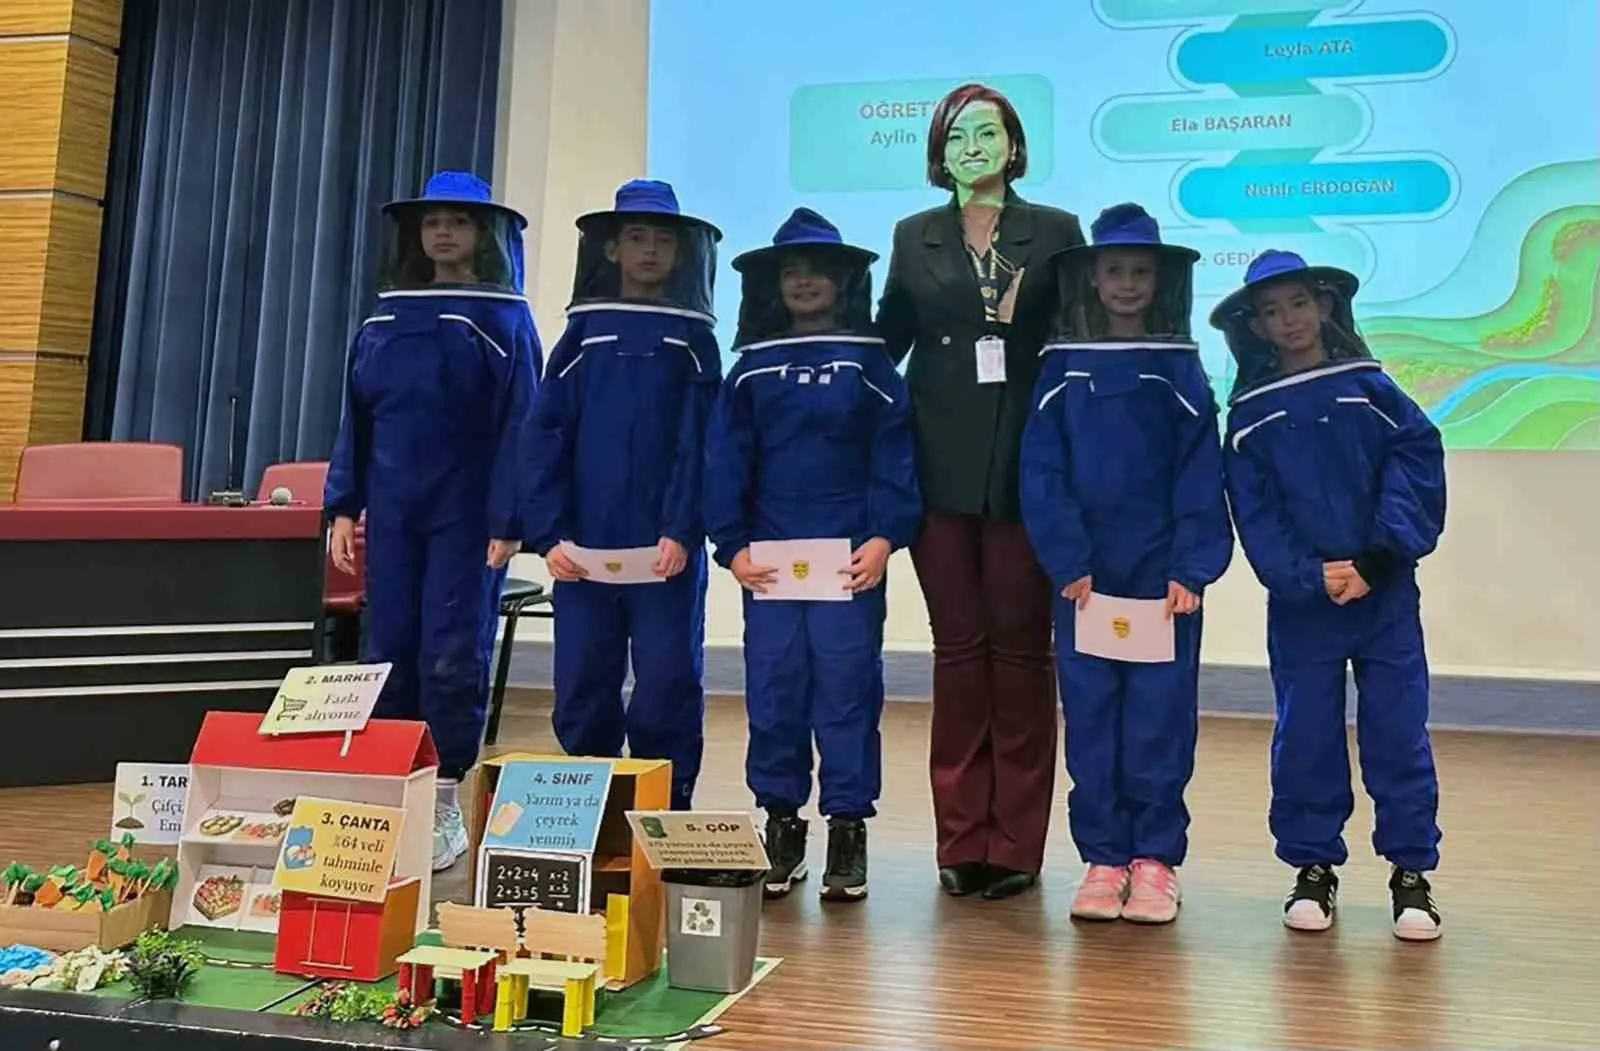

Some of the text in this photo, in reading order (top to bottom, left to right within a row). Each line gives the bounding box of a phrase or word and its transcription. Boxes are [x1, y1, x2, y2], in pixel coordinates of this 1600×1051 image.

[1264, 40, 1353, 58] Leyla ATA
[860, 100, 935, 119] ÖĞRET
[1171, 114, 1292, 132] Ela BAŞARAN
[871, 129, 917, 148] Aylin
[1301, 176, 1395, 195] ERDOĞAN
[1214, 248, 1256, 266] GEDİ
[321, 672, 383, 683] MARKET
[324, 692, 360, 705] Fazla
[142, 775, 188, 788] 1. TAR
[534, 772, 594, 785] 4. SINIF
[525, 793, 600, 808] Yarım ya da
[160, 818, 182, 832] Em
[321, 812, 390, 832] 3. ÇANTA
[535, 812, 579, 828] çeyrek
[706, 822, 740, 833] ÇÖP
[361, 840, 385, 853] veli
[528, 832, 576, 848] yenmiş
[323, 854, 383, 873] tahminle
[320, 873, 375, 894] koyuyor
